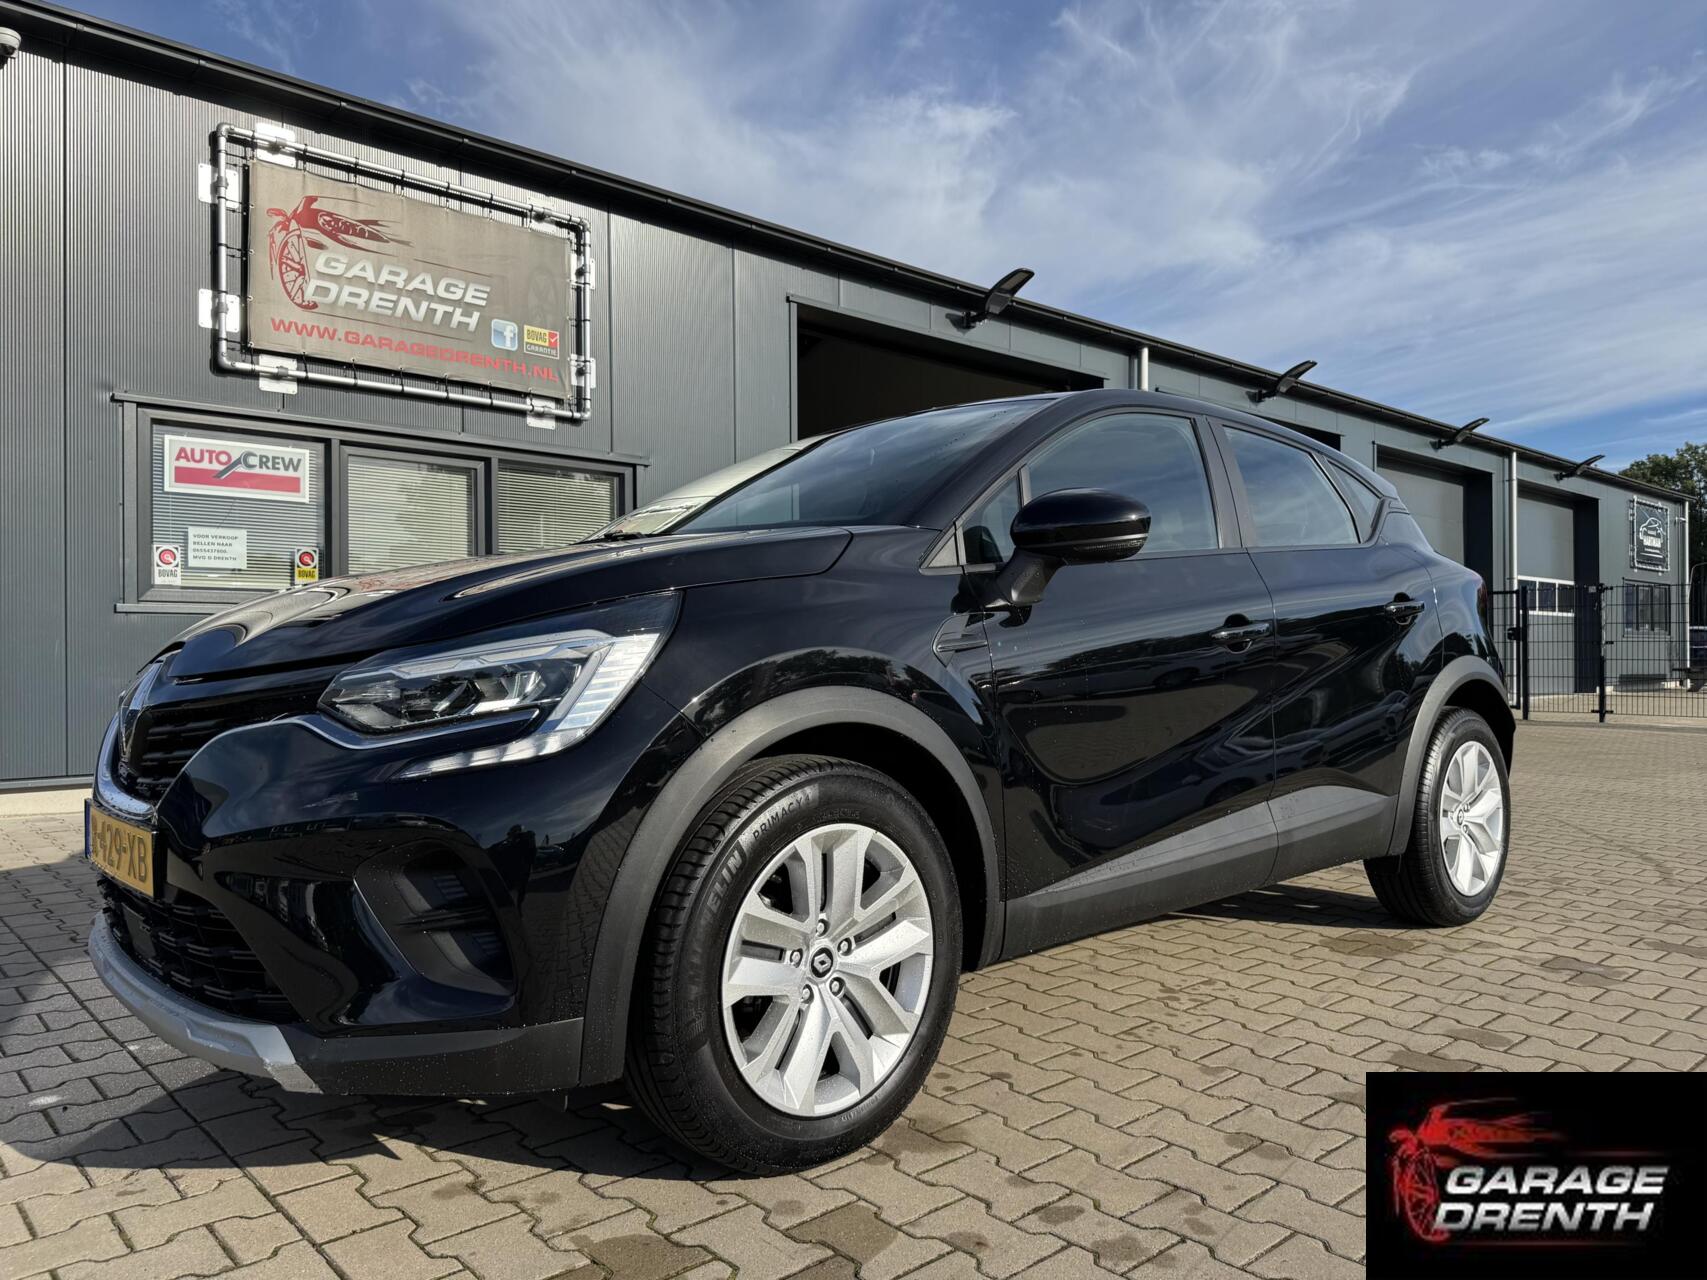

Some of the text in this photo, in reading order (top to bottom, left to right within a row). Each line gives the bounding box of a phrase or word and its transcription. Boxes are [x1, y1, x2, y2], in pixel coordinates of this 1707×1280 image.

[314, 251, 492, 307] GARAGE
[303, 278, 481, 332] DRENTH
[270, 317, 559, 383] WWW.GARAGEDRENTH.NL
[526, 329, 547, 344] BOVAG
[158, 569, 178, 578] BOVAG
[297, 569, 316, 579] BOVAG
[752, 797, 804, 841] PRIMACY
